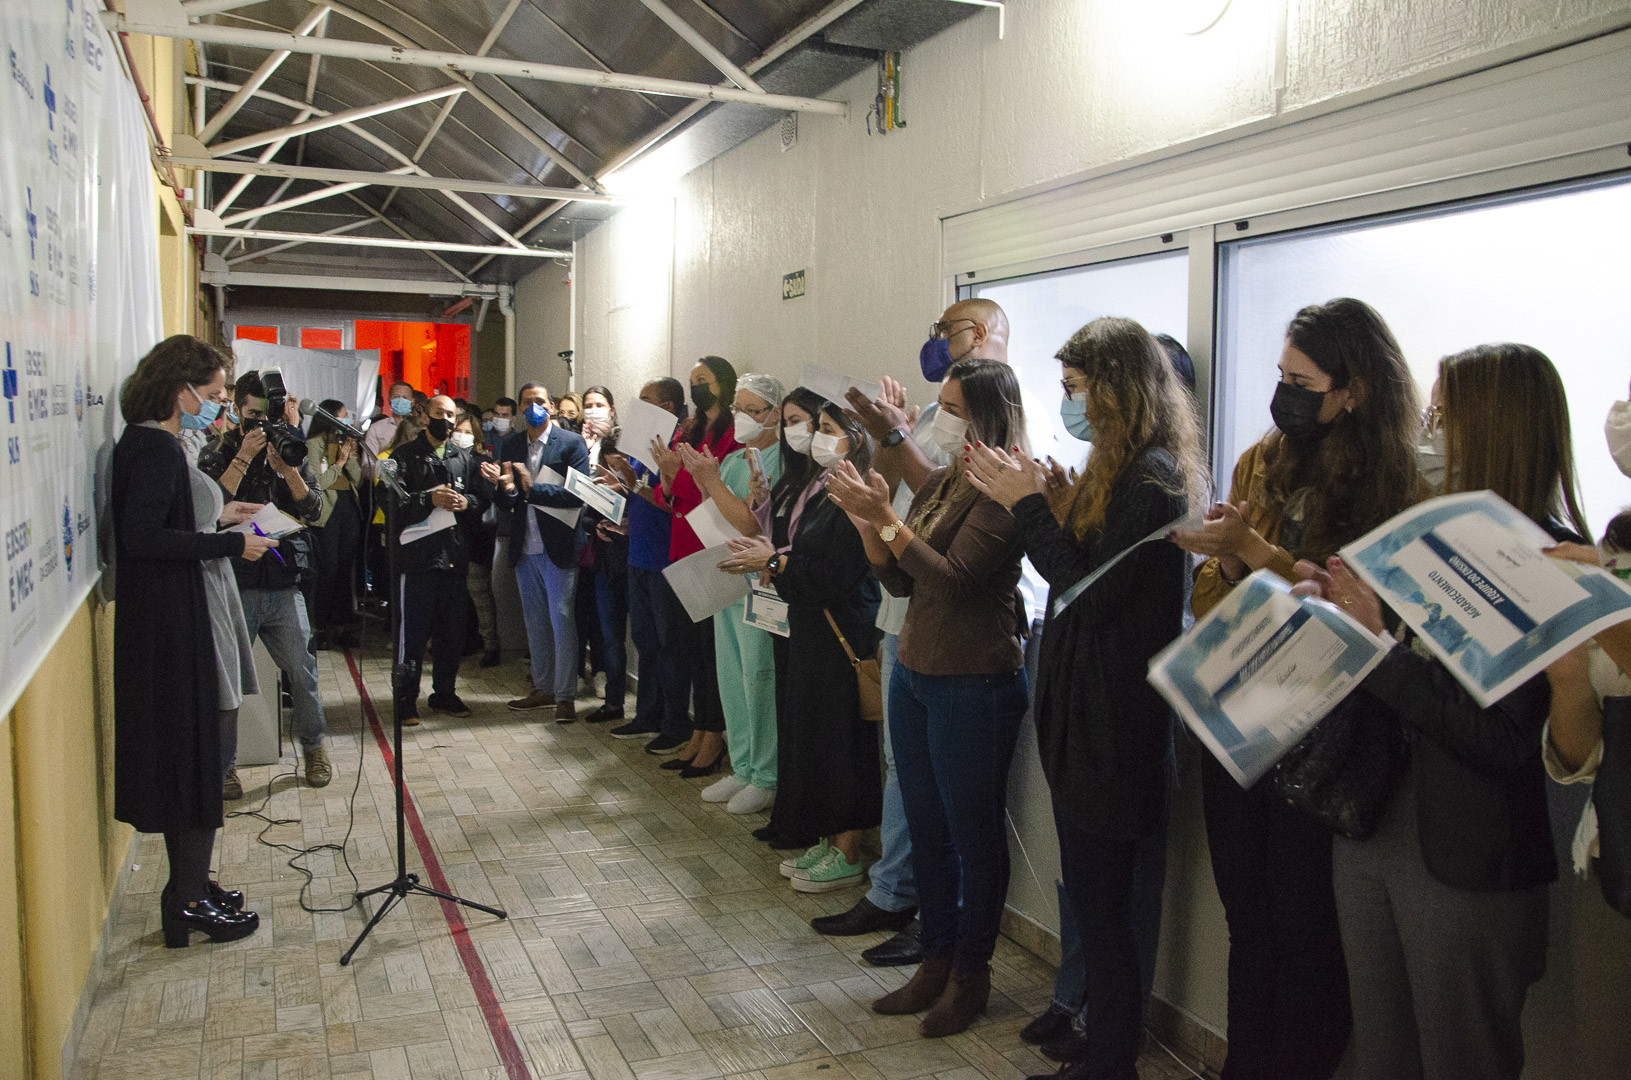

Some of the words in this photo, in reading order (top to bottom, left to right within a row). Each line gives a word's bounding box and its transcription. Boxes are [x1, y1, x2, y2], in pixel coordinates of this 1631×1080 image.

[1448, 555, 1473, 577] ENSINO
[1466, 571, 1481, 583] DO
[16, 558, 34, 605] MEC
[1474, 578, 1500, 601] EQUIPE
[1428, 569, 1482, 619] AGRADECIMENTO
